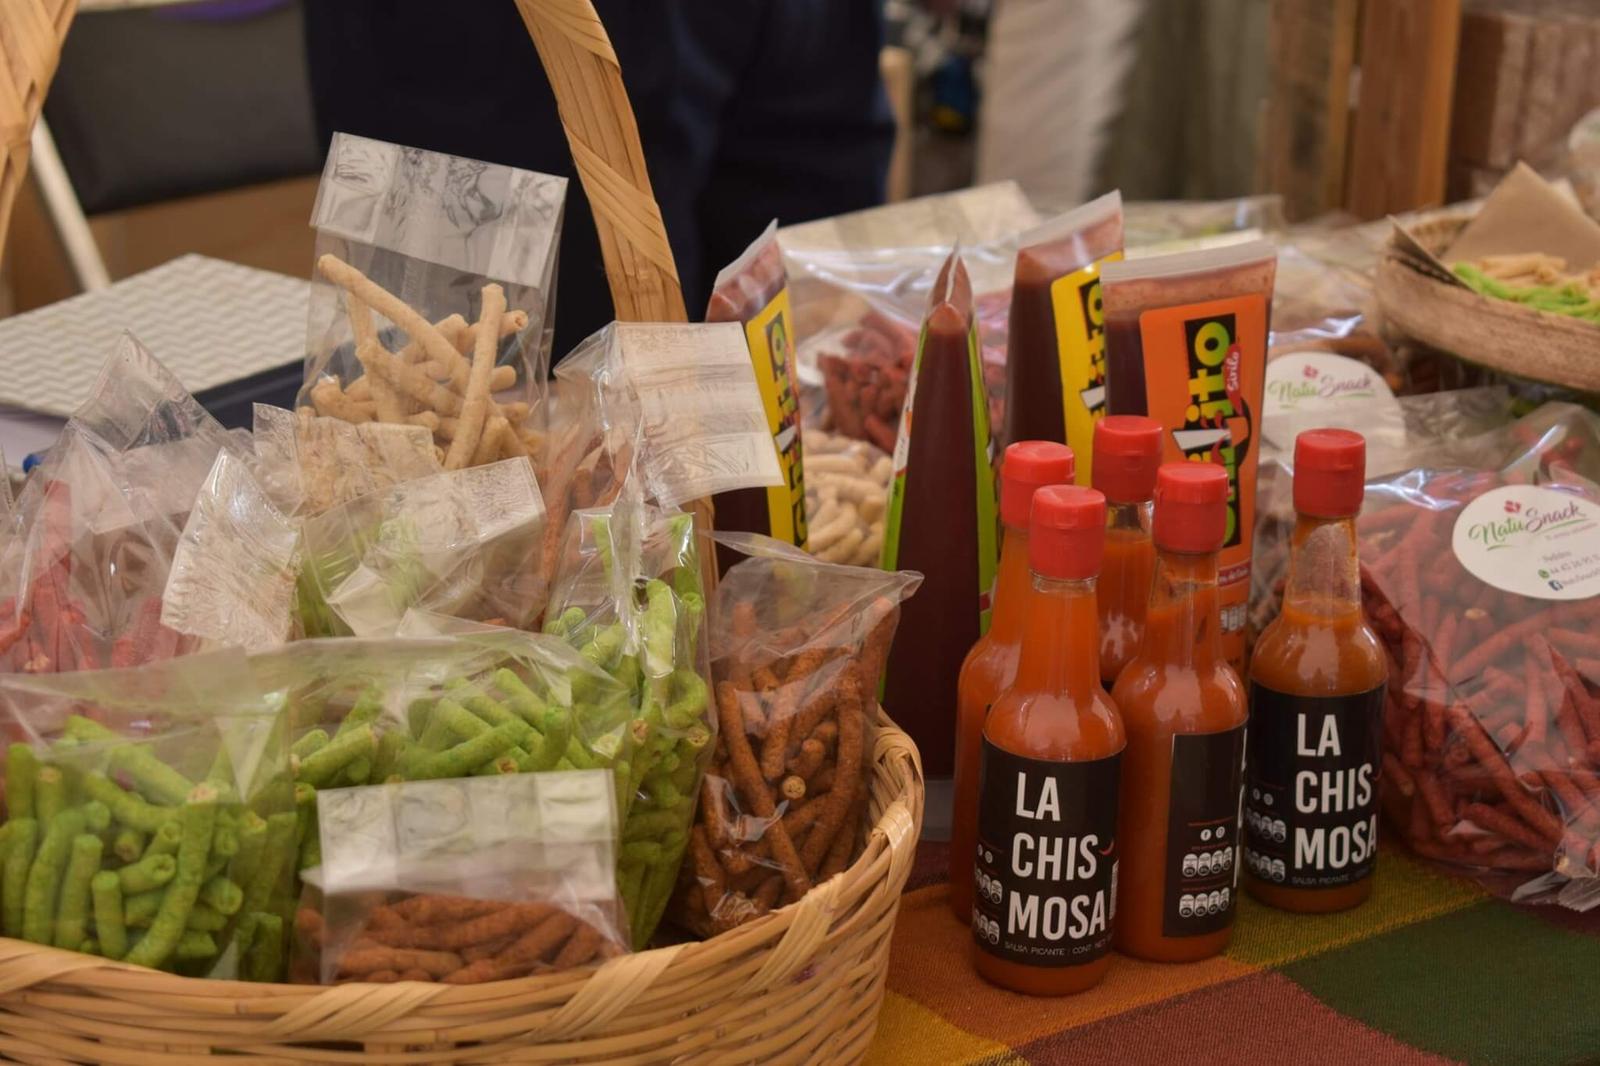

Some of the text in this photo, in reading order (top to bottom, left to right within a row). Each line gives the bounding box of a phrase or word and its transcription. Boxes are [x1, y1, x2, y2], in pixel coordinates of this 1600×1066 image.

[1297, 713, 1341, 757] LA
[1016, 771, 1061, 822] LA
[1295, 762, 1373, 814] CHIS
[1011, 832, 1099, 881] CHIS
[1294, 813, 1377, 870] MOSA
[1007, 889, 1106, 940] MOSA
[1031, 946, 1065, 956] PICANTE
